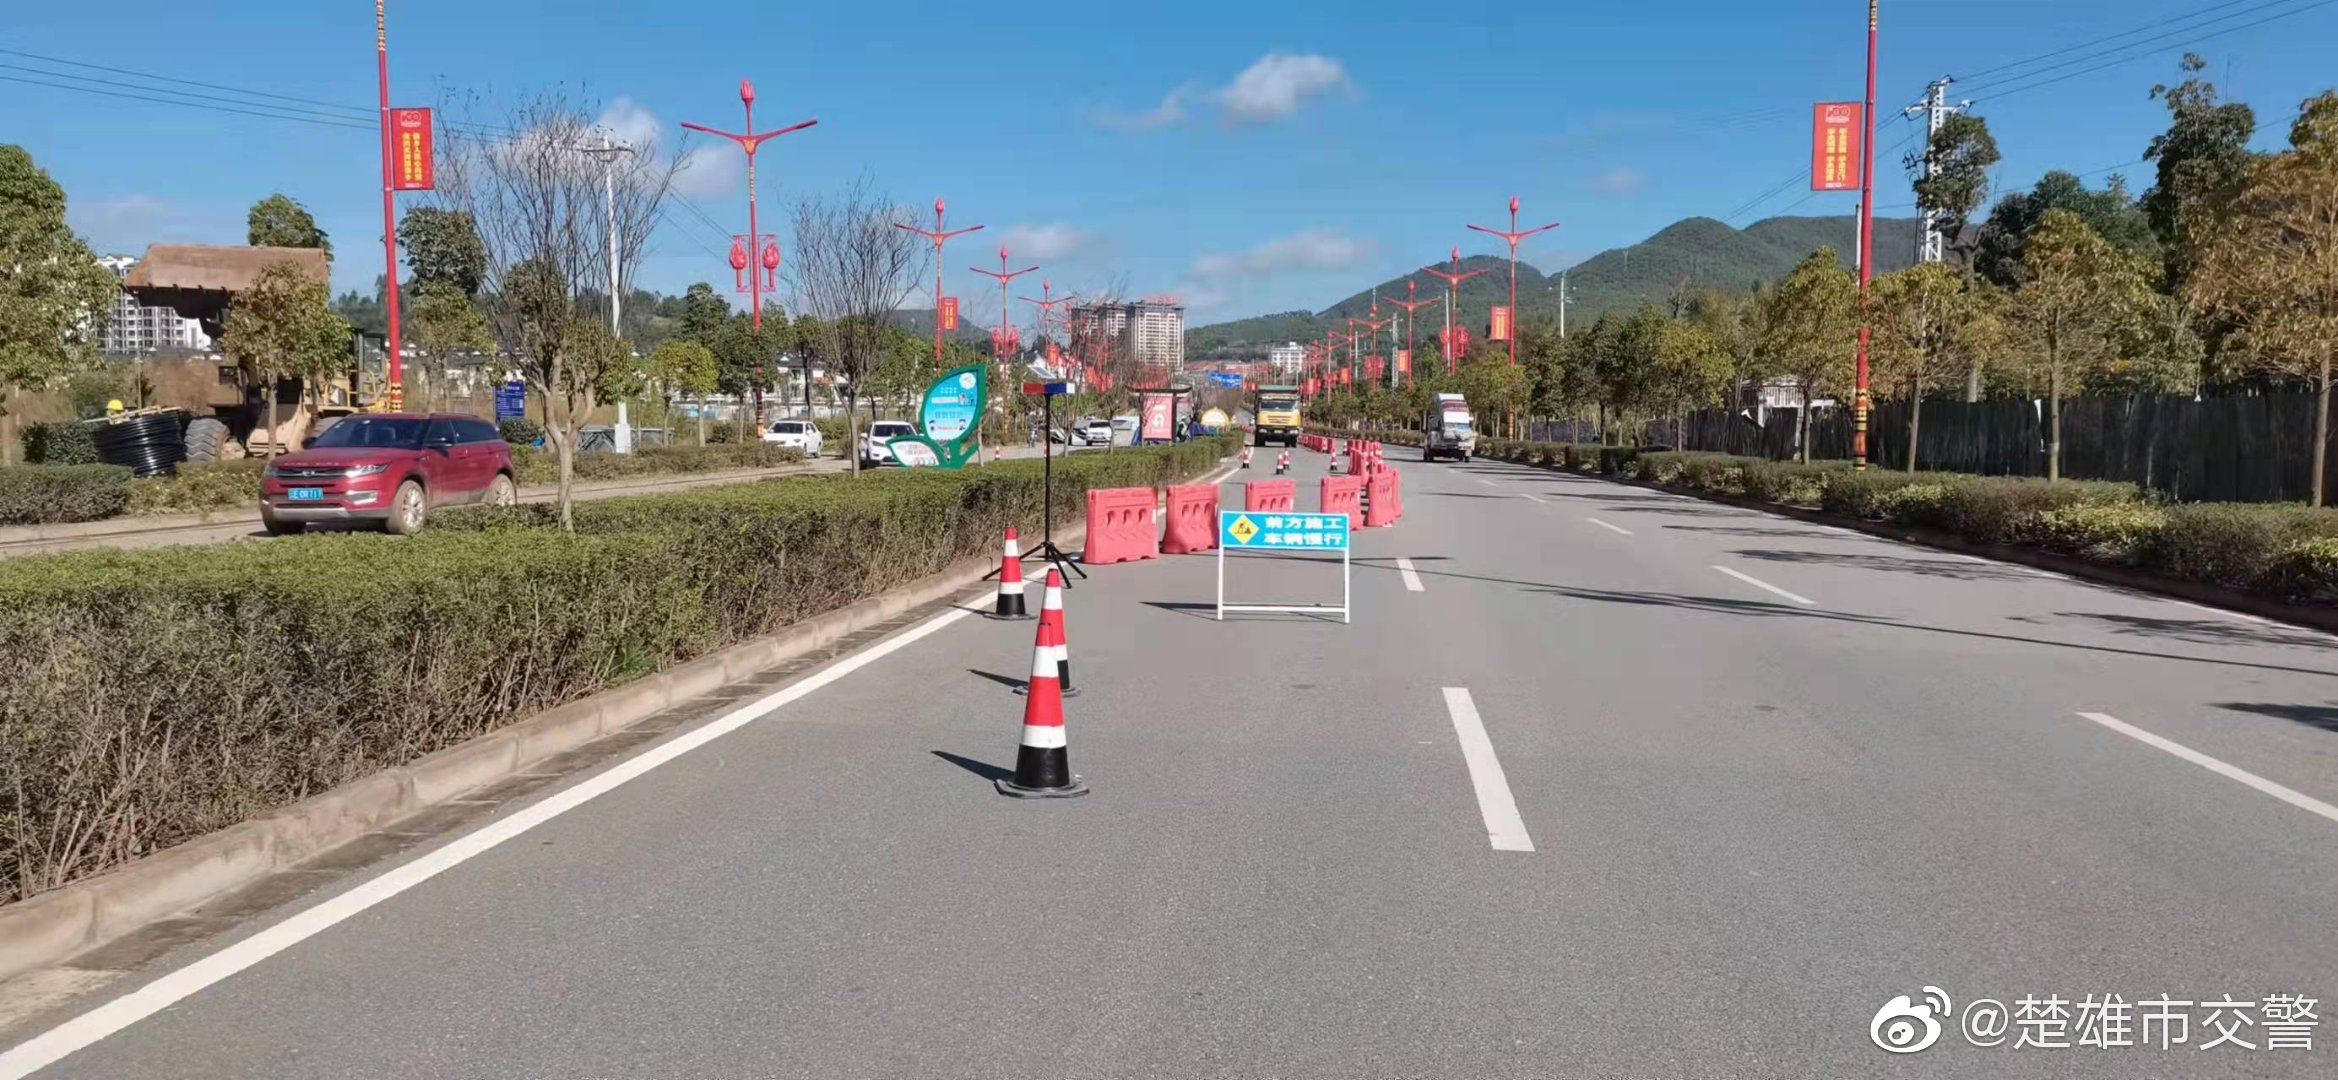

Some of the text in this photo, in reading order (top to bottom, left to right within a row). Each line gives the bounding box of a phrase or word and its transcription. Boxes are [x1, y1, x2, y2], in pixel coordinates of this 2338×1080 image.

[1265, 516, 1344, 529] 前方施工
[1264, 532, 1344, 545] 车辆慢行
